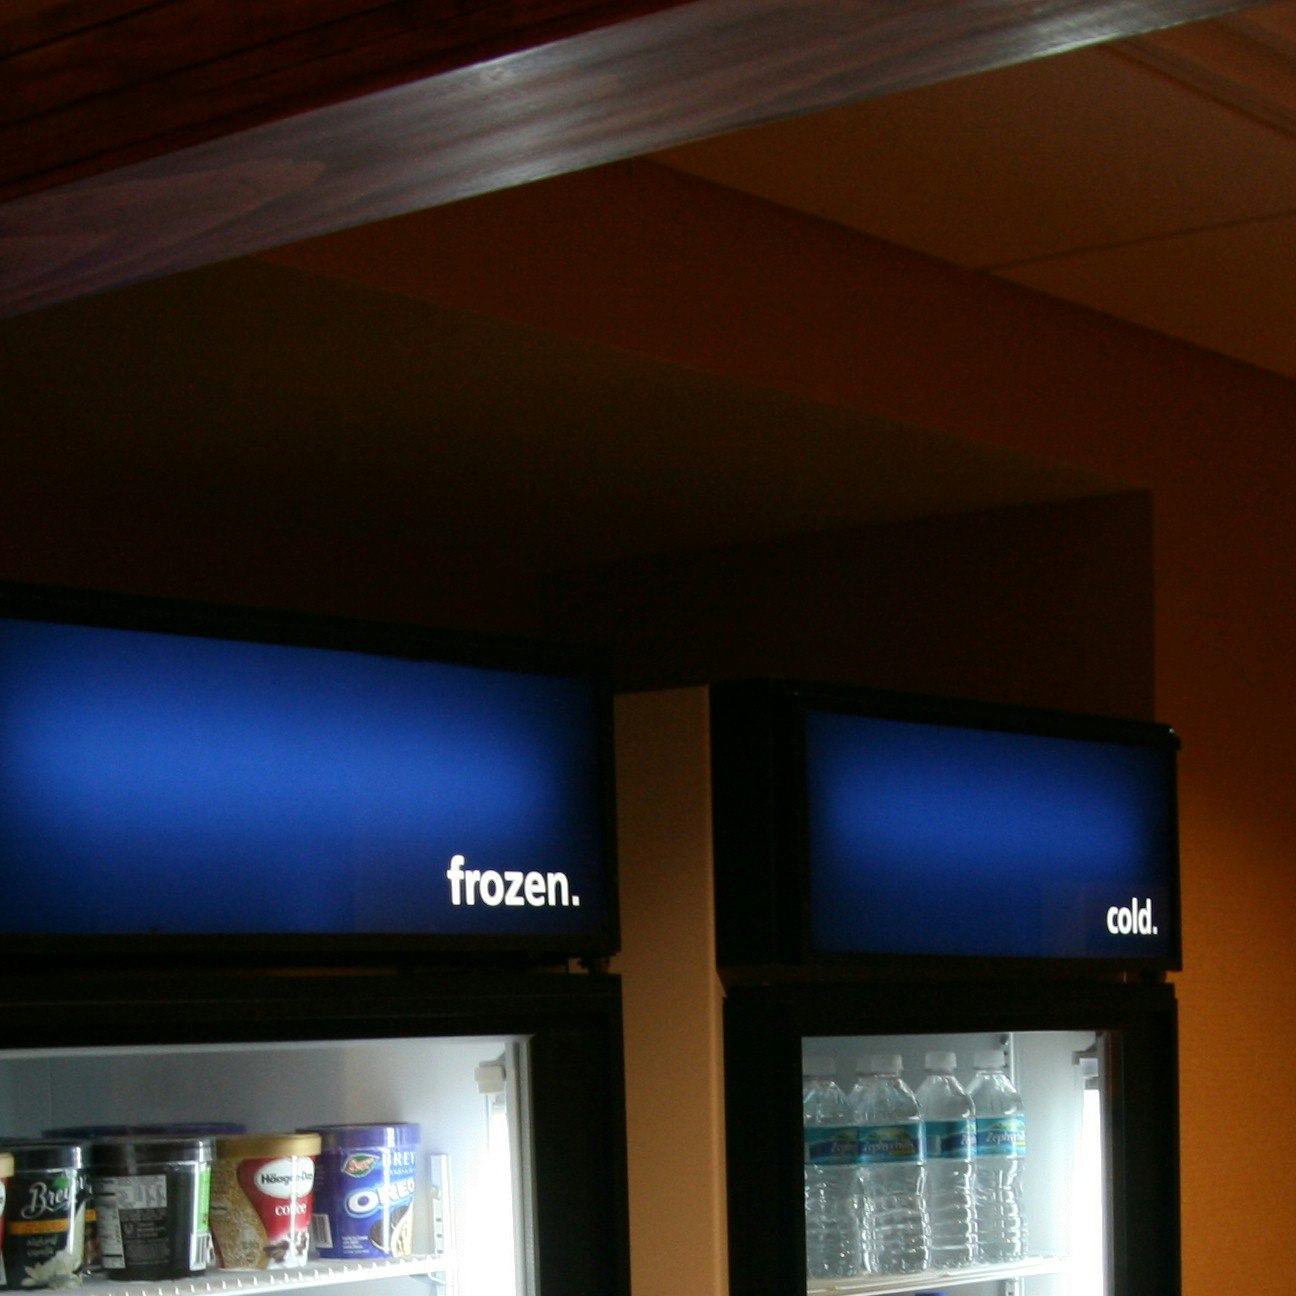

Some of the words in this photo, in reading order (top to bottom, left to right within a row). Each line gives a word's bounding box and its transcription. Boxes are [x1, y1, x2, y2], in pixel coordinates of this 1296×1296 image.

[447, 855, 580, 907] frozen.
[1106, 898, 1159, 936] cold.
[348, 1181, 415, 1214] OREO
